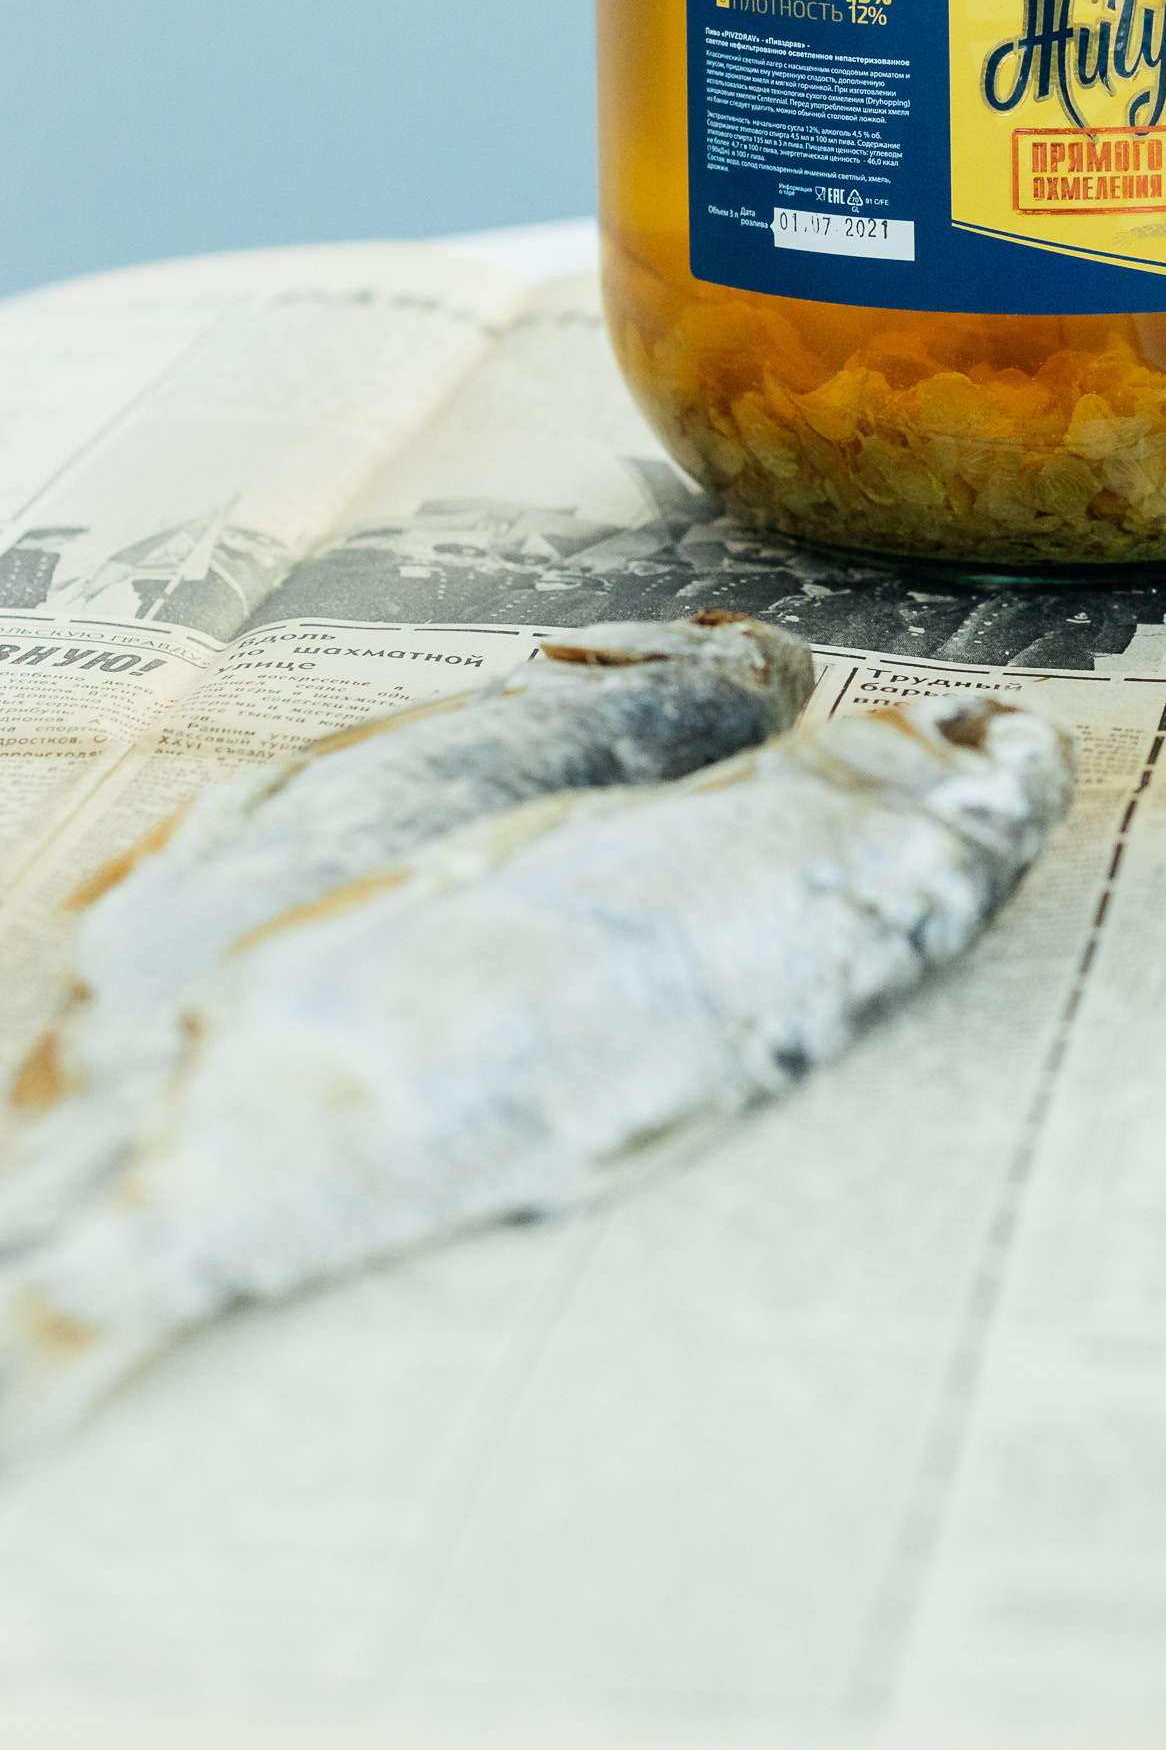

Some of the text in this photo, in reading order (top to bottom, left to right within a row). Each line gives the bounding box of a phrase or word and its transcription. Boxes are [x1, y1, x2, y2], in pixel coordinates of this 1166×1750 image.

[848, 5, 888, 26] 12%
[705, 26, 720, 36] Пиво
[788, 50, 833, 61] осветленное
[834, 55, 910, 66] непастеризованное
[869, 71, 904, 79] ароматом
[837, 77, 885, 88] дополненную
[834, 84, 848, 94] При
[851, 129, 862, 138] 4,5
[815, 134, 827, 142] 100
[856, 138, 900, 148] Содержание
[869, 149, 902, 158] углеводы
[1031, 138, 1163, 174] ПРЯМОГО
[866, 156, 881, 165] 46,0
[1032, 174, 1163, 202] ОХМЕЛЕНИЯ
[708, 205, 756, 217] Объем Дата
[741, 219, 768, 229] розлива
[228, 646, 485, 668] по шахматной
[215, 661, 317, 675] улице
[867, 667, 1023, 692] Трудный
